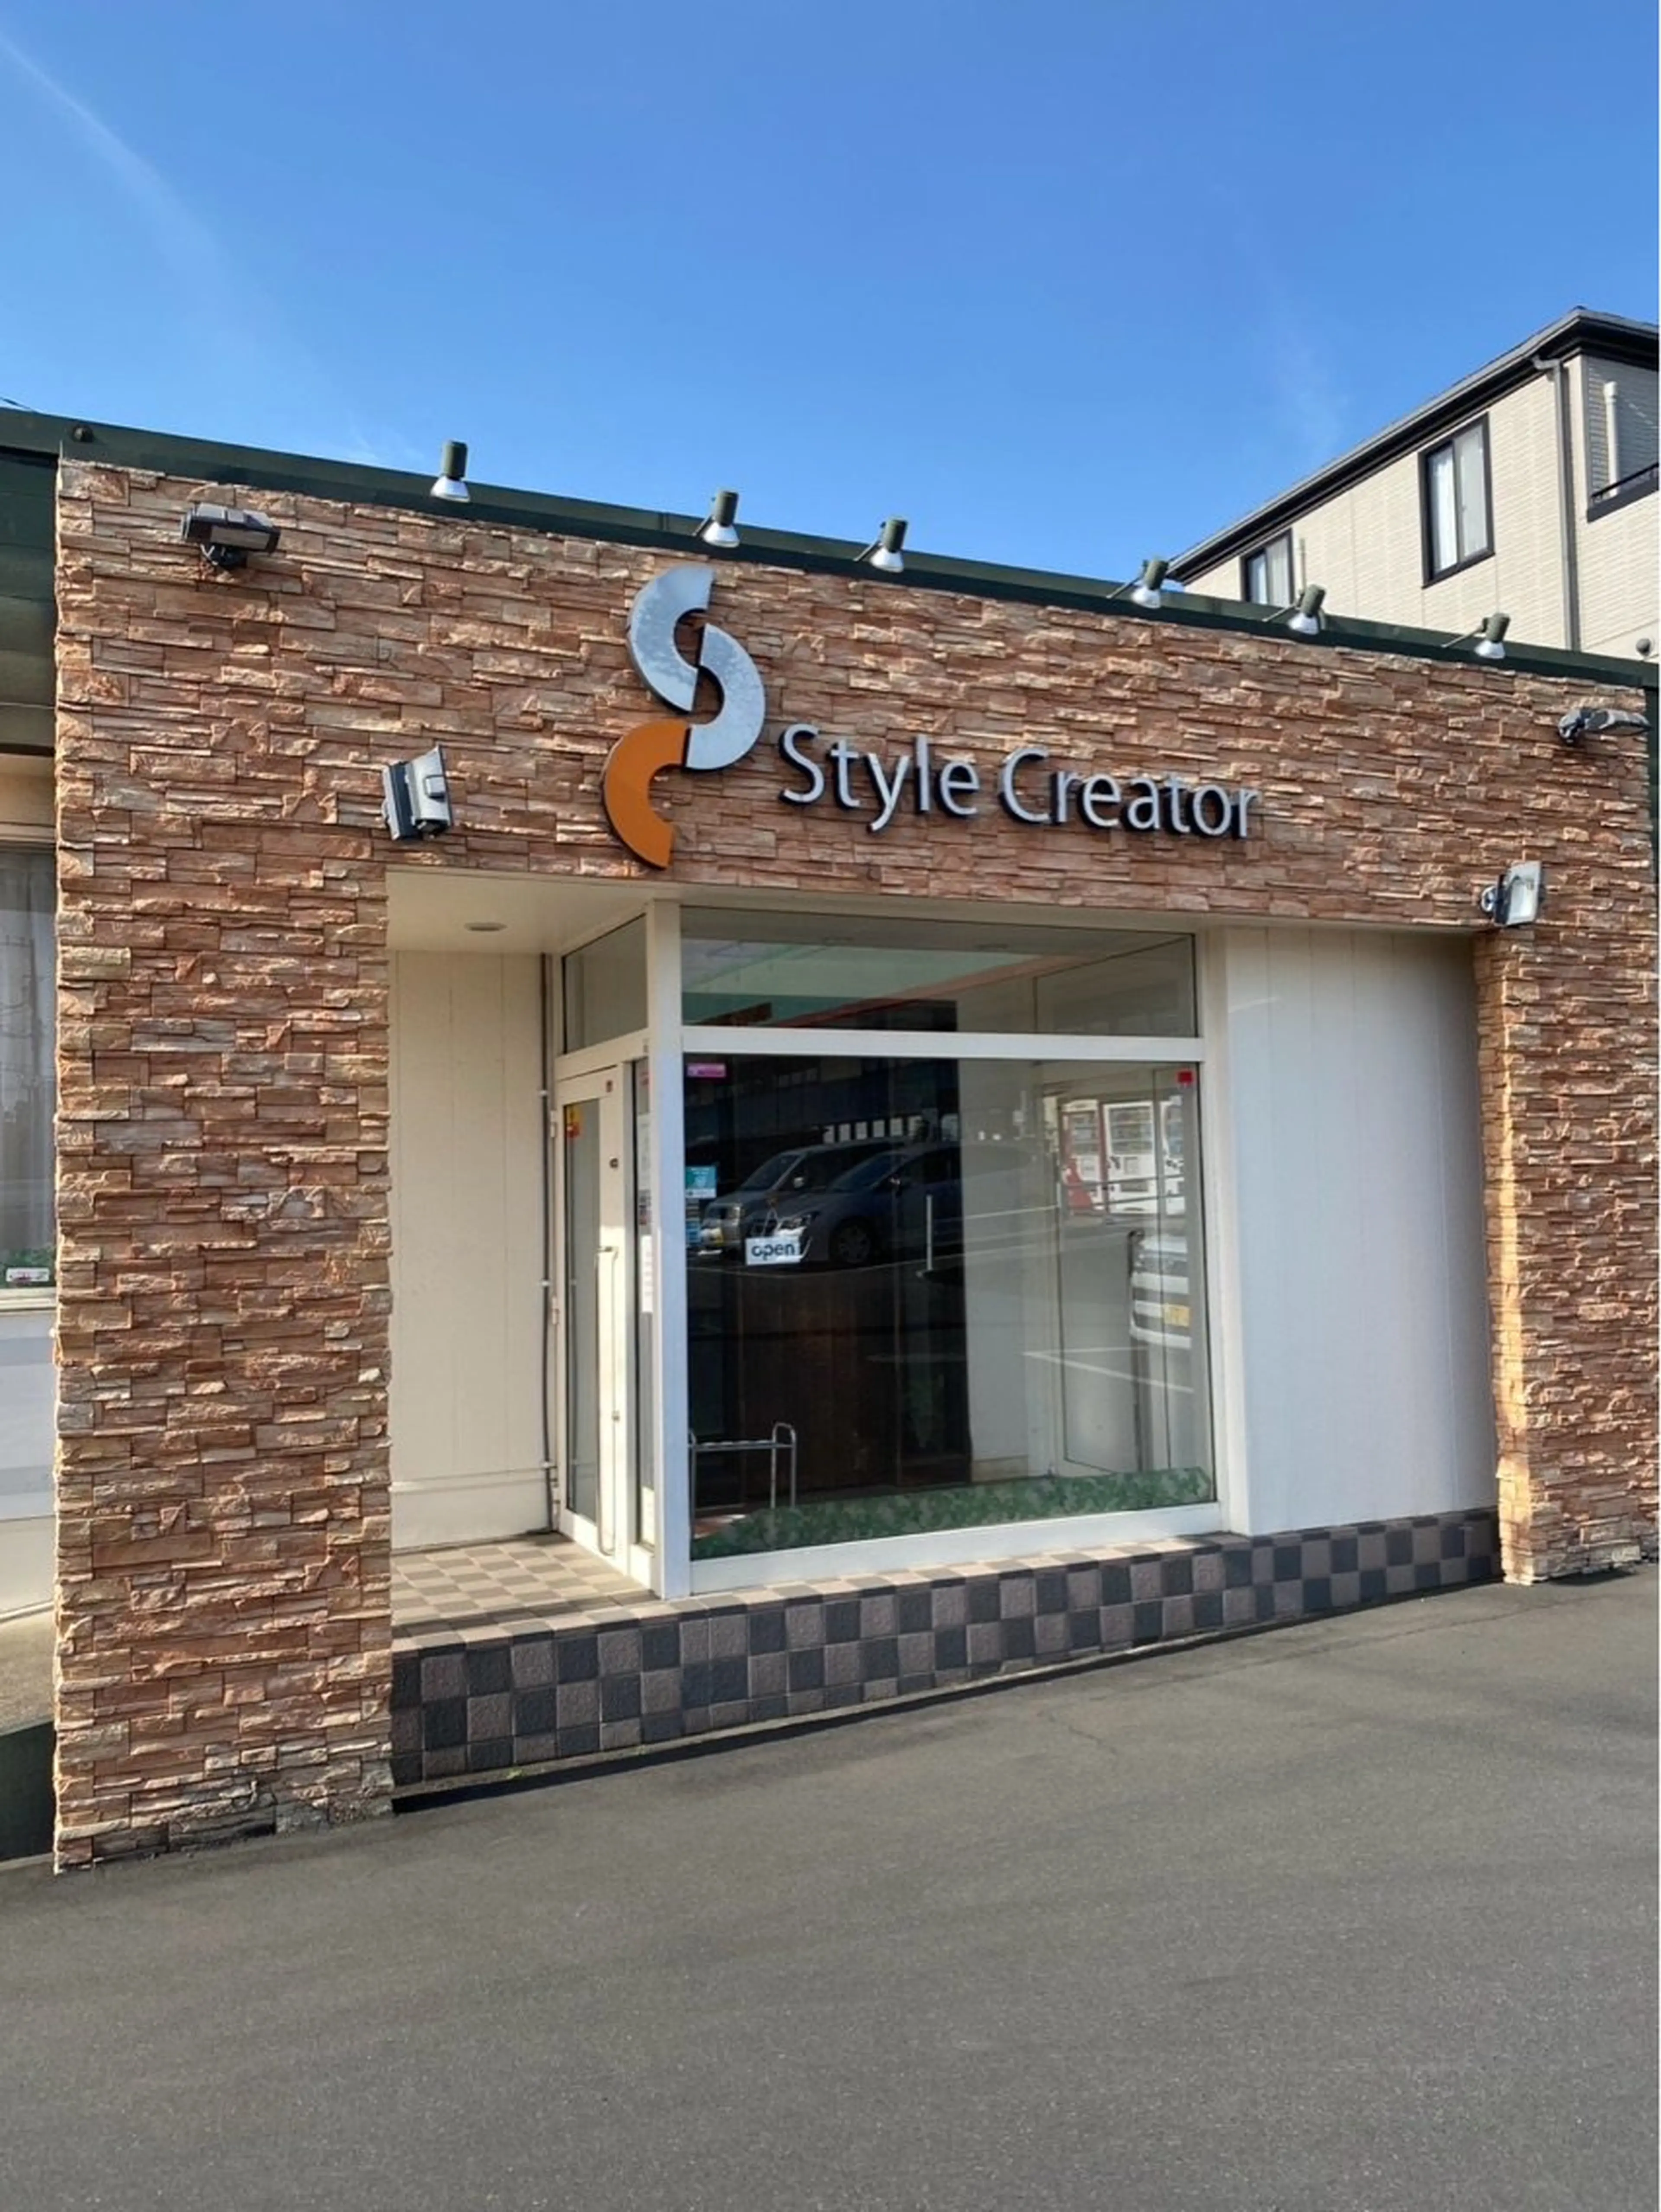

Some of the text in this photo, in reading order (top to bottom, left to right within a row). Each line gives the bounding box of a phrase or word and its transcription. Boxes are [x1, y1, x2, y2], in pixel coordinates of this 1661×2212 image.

[781, 723, 1259, 838] Style Creator
[752, 1244, 795, 1260] open
